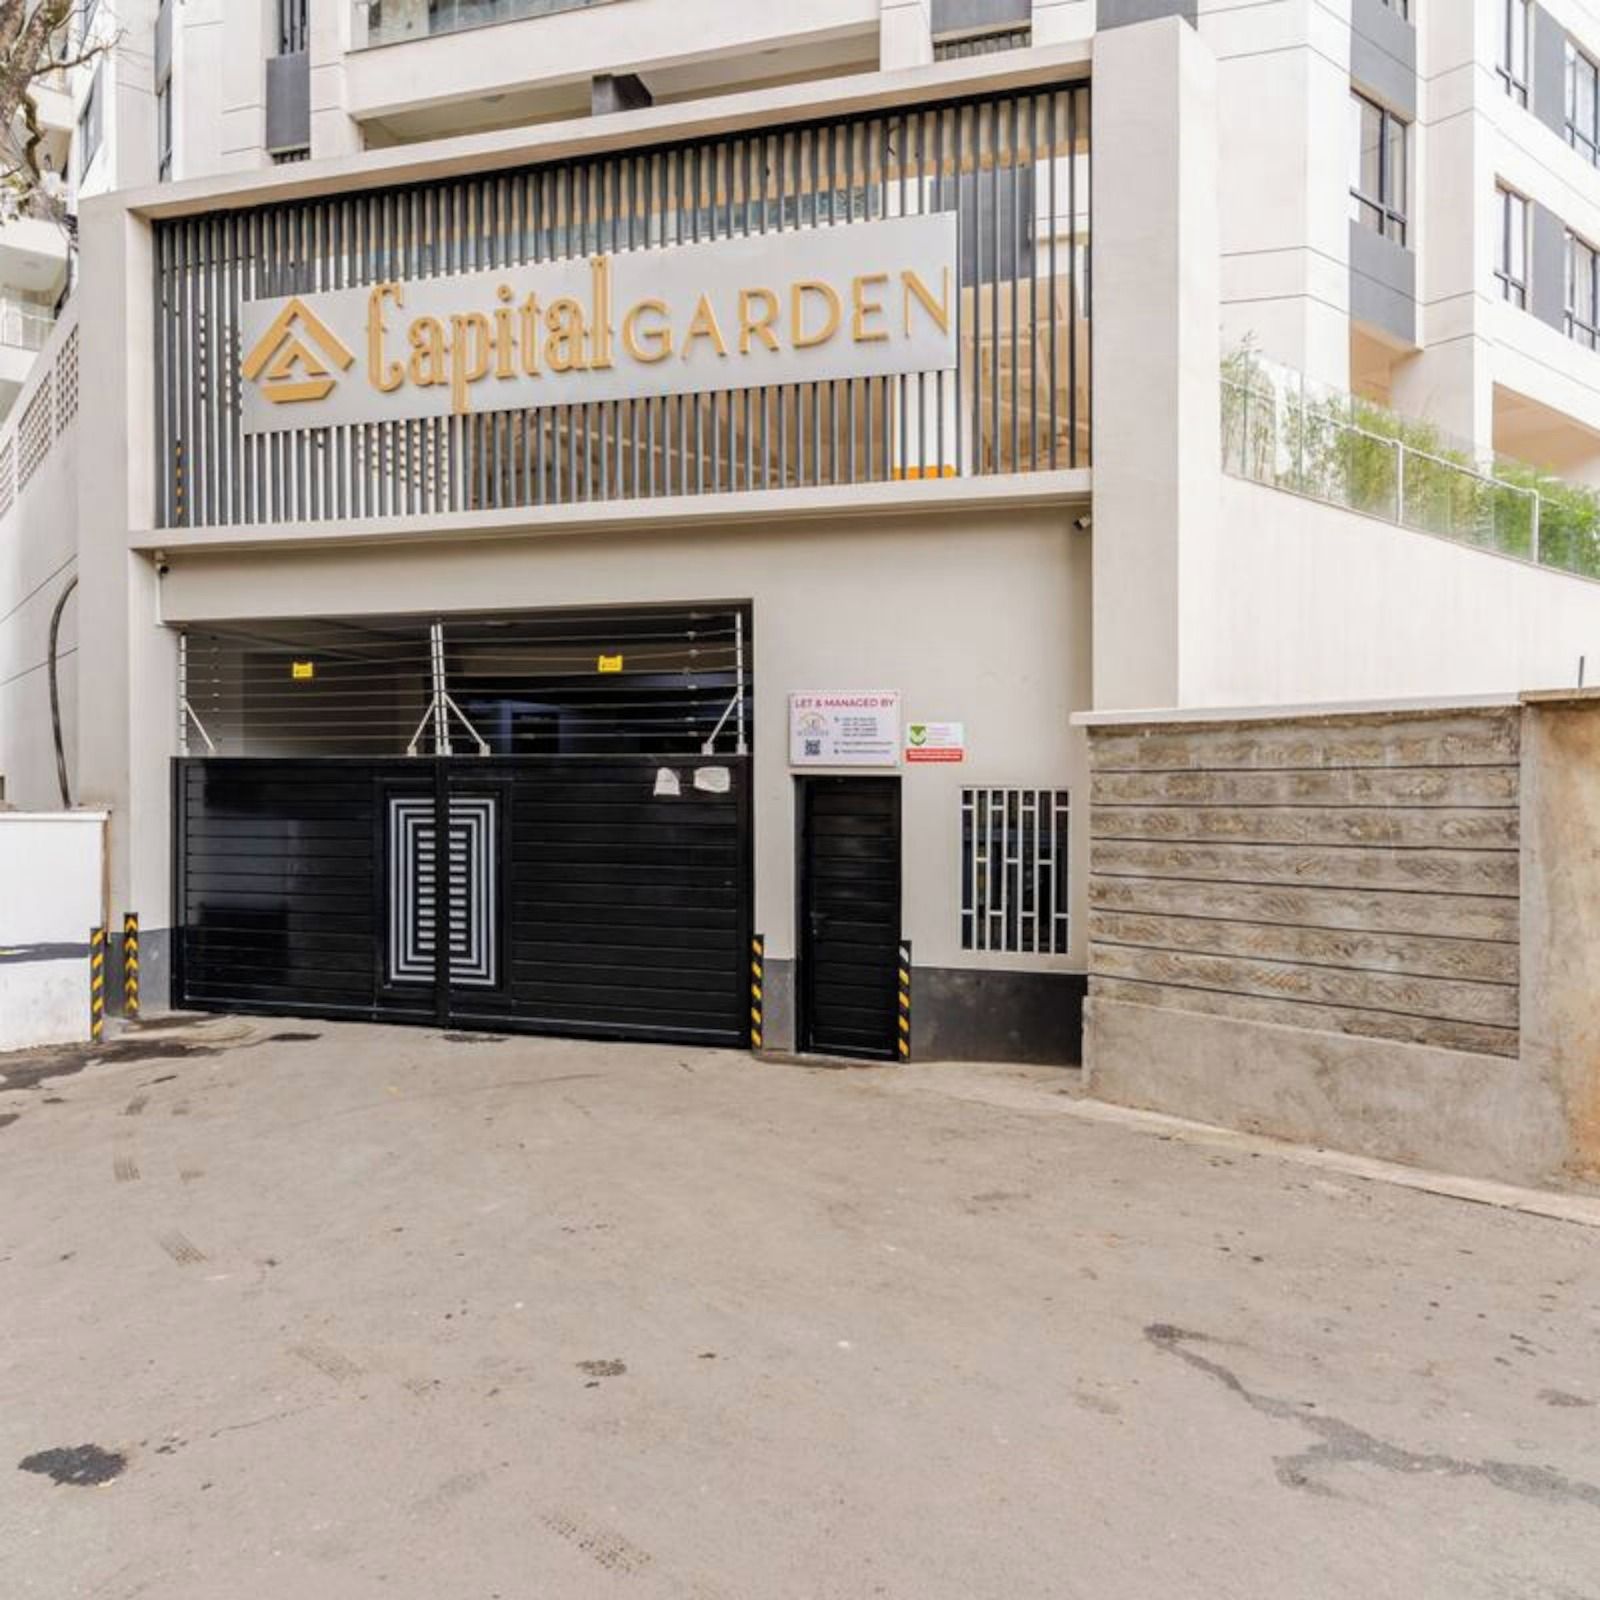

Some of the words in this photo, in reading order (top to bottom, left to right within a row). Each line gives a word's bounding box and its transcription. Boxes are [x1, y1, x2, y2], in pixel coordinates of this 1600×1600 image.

[366, 256, 614, 414] Capital
[622, 266, 951, 362] GARDEN
[795, 698, 812, 709] LET
[815, 698, 822, 708] &
[824, 697, 878, 708] MANAGED
[881, 697, 895, 708] BY
